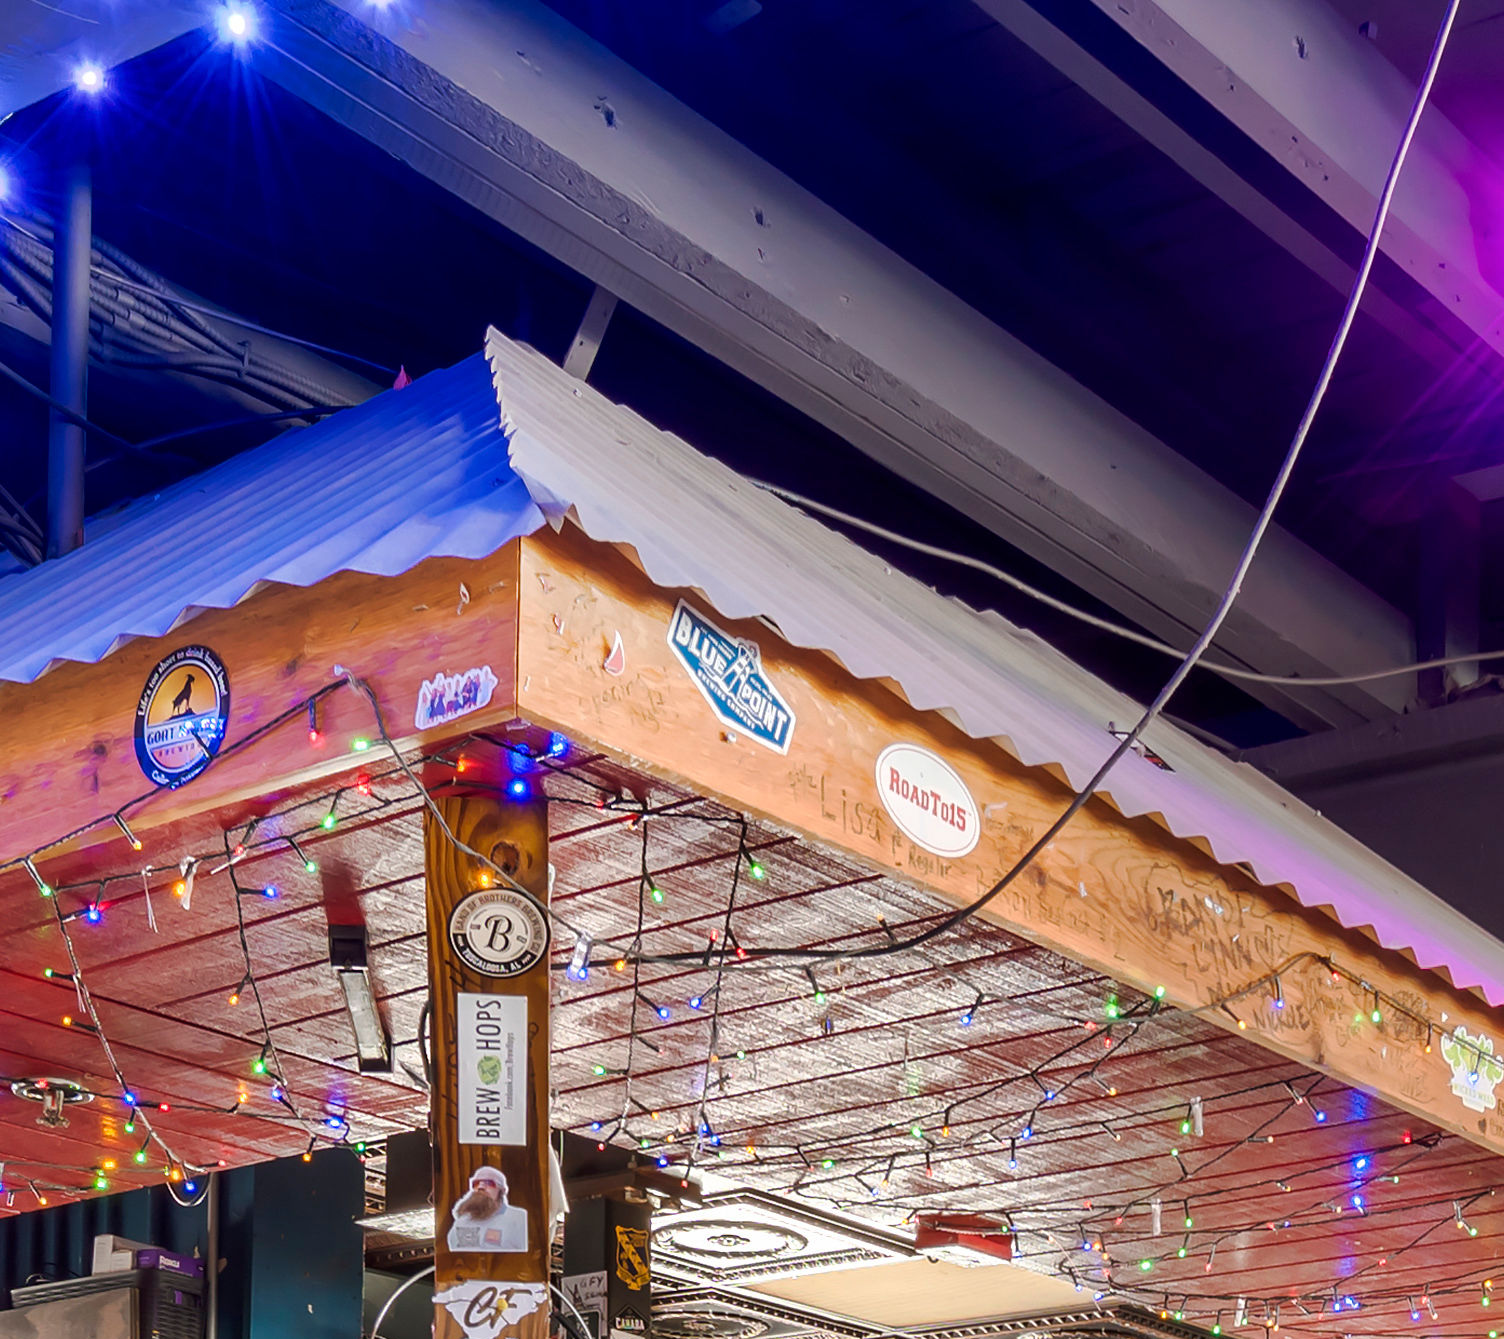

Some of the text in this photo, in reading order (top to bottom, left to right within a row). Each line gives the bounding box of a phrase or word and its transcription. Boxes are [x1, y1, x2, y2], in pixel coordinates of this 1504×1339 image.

[675, 611, 787, 740] BLUE POINT
[479, 893, 521, 907] BROTHERS
[485, 915, 512, 952] B
[476, 1000, 501, 1139] BREW HOPS
